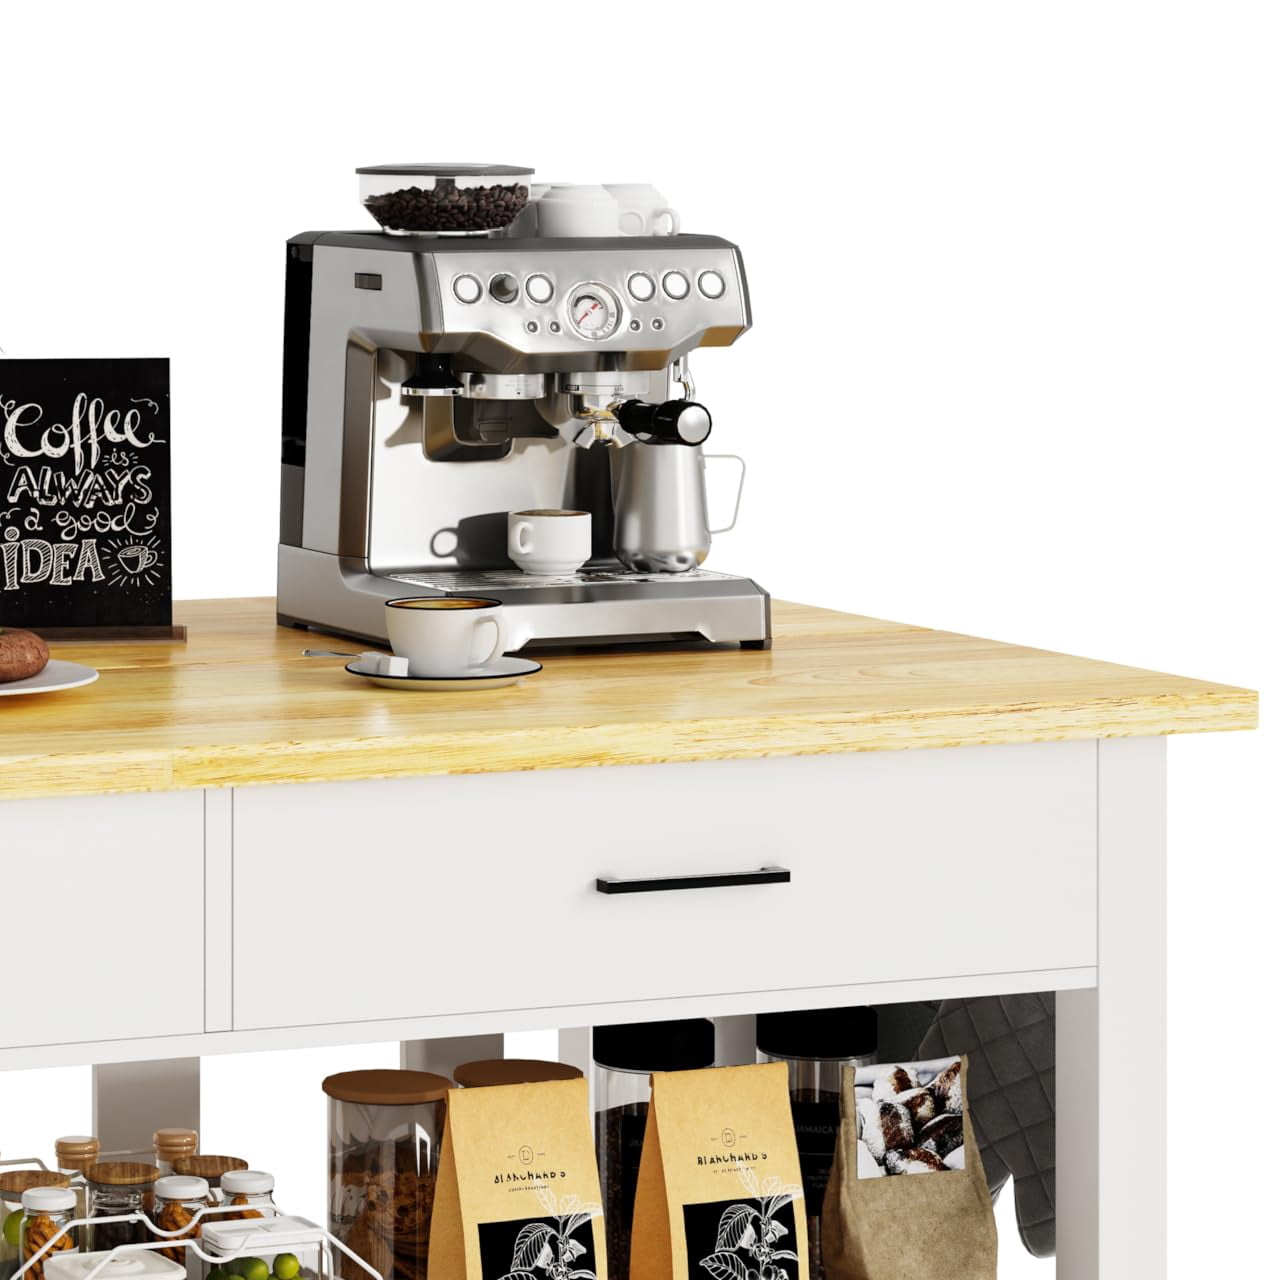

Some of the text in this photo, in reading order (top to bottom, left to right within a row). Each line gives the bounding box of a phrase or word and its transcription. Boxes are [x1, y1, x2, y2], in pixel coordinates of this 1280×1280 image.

[1, 392, 166, 475] Coffee
[111, 448, 129, 466] is
[7, 465, 152, 508] ALWAYS
[24, 502, 153, 541] a good
